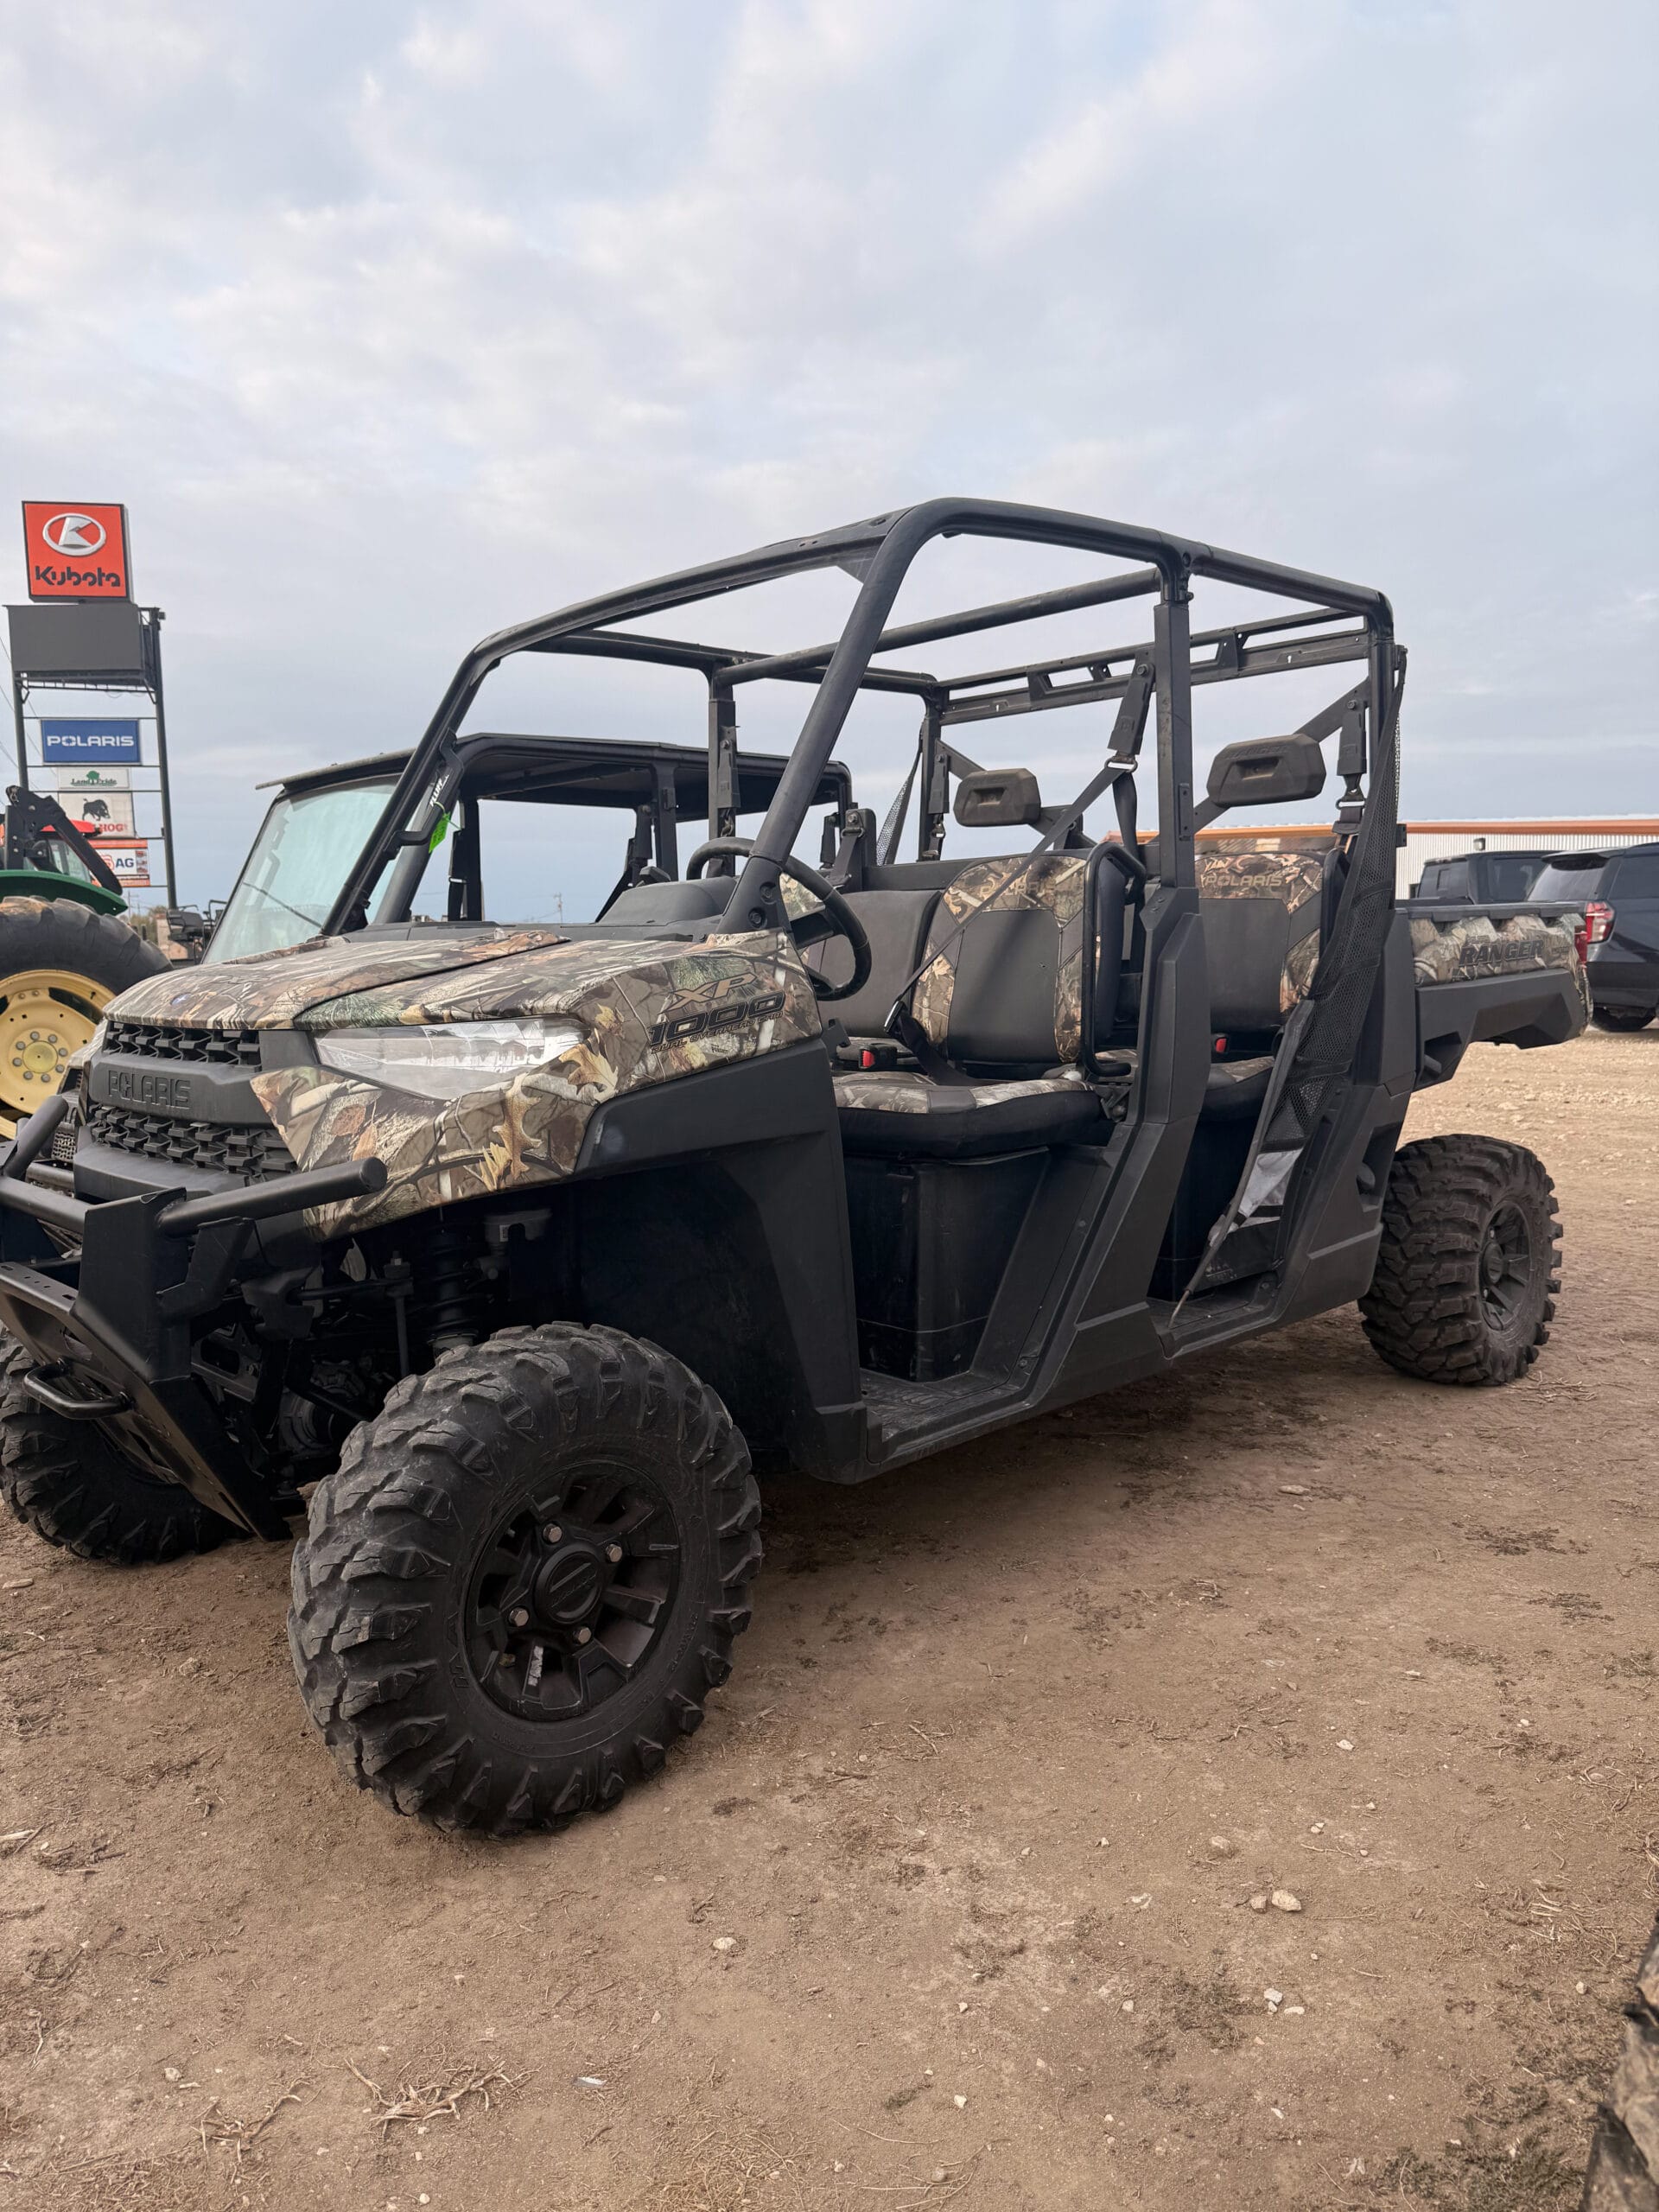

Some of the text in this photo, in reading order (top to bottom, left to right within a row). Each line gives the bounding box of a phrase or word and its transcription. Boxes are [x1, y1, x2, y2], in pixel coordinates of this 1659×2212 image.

[35, 565, 121, 588] Kubota
[47, 735, 134, 747] POLARIS
[115, 858, 135, 868] AG
[1205, 874, 1283, 887] POLARIS
[1459, 938, 1544, 967] RANGER
[658, 972, 758, 1015] XP
[648, 989, 786, 1046] 1000
[651, 1010, 784, 1054] DUAL OVERHEAD CAM
[108, 1070, 191, 1109] POLARIS
